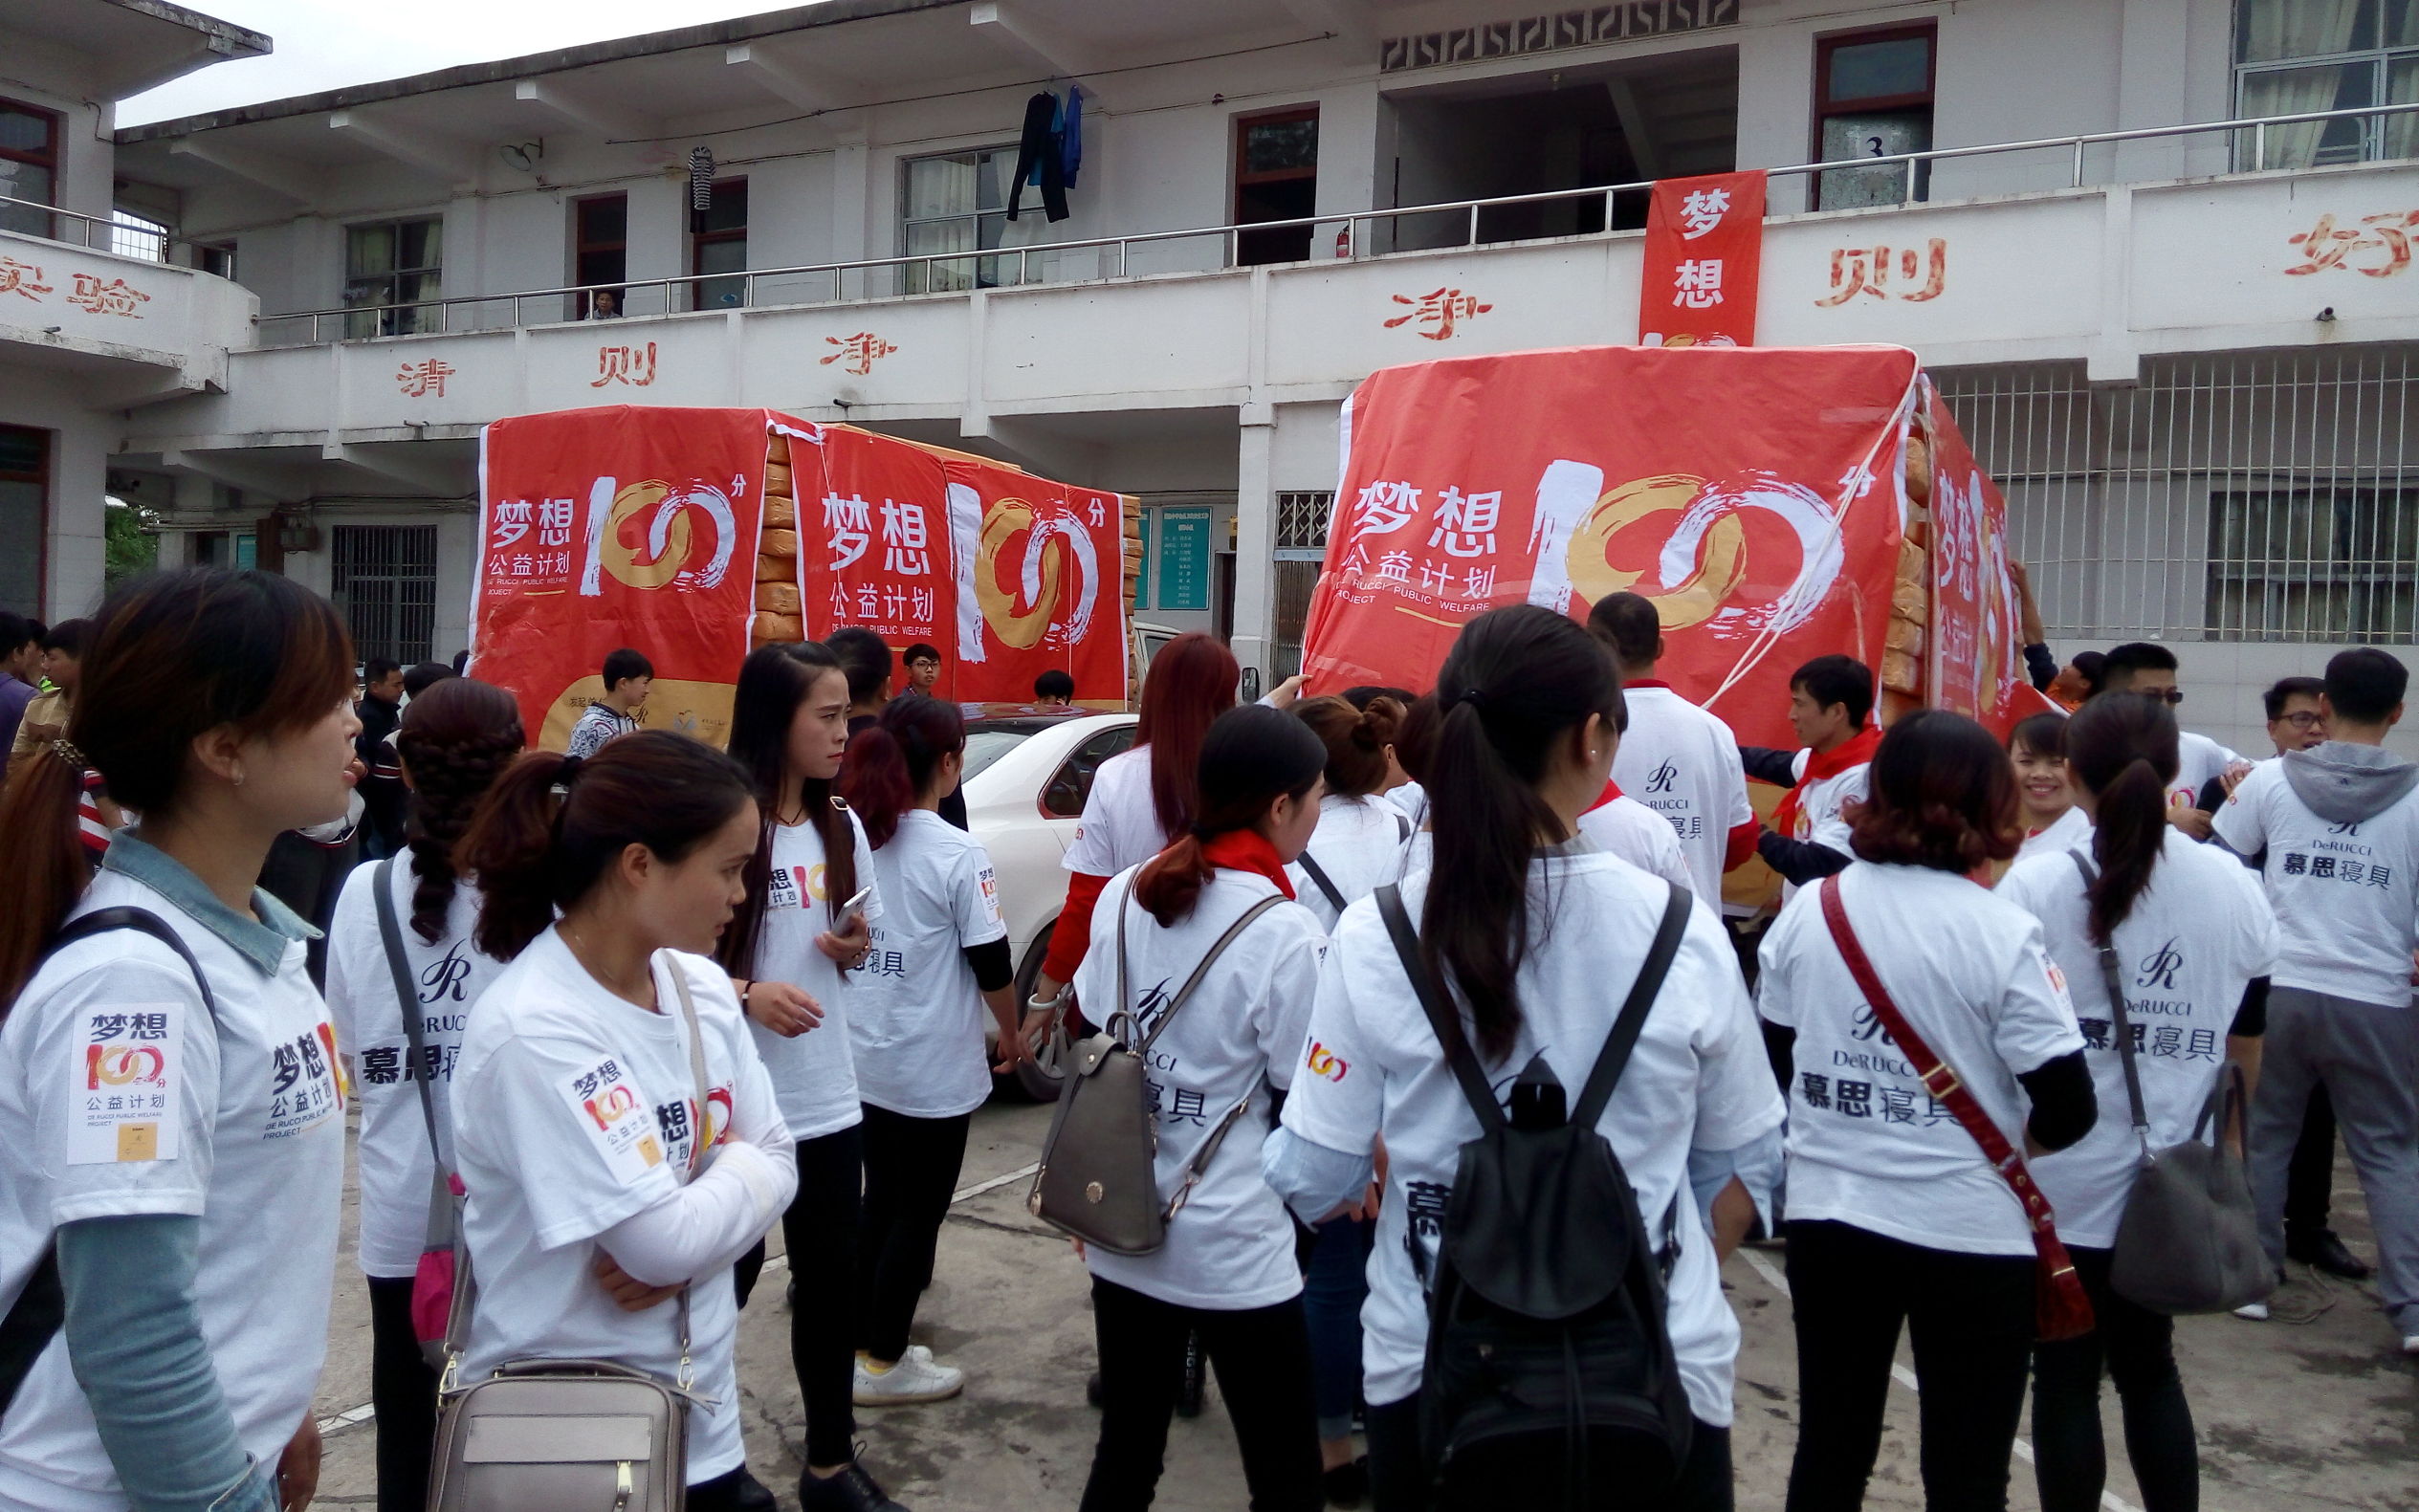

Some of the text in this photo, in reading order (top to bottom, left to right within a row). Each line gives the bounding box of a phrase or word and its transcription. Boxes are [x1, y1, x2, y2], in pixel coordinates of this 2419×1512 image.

[1671, 187, 1730, 308] 梦想
[1814, 238, 1946, 307] 则
[396, 359, 455, 398] 清
[590, 341, 656, 387] 则
[731, 473, 747, 497] 分
[493, 498, 574, 549] 梦想
[1088, 497, 1106, 528] 分
[1350, 479, 1503, 558] 梦想
[821, 492, 931, 576] 梦想
[489, 550, 570, 576] 公益计划
[1341, 543, 1496, 599] 公益计划
[829, 581, 934, 623] 公益计划
[1394, 586, 1432, 604] PUBLIC
[1440, 600, 1490, 613] WELFARE
[902, 625, 933, 636] WELFARE
[2313, 840, 2372, 857] DeRUCCI
[2283, 852, 2391, 890] 慕思寝具
[91, 1013, 167, 1042] 梦想
[273, 1032, 325, 1096] 梦想
[573, 1060, 622, 1101] 梦想
[87, 1094, 165, 1110] 公益计划
[657, 1100, 689, 1143] 想
[263, 1127, 300, 1140] PROJECT
